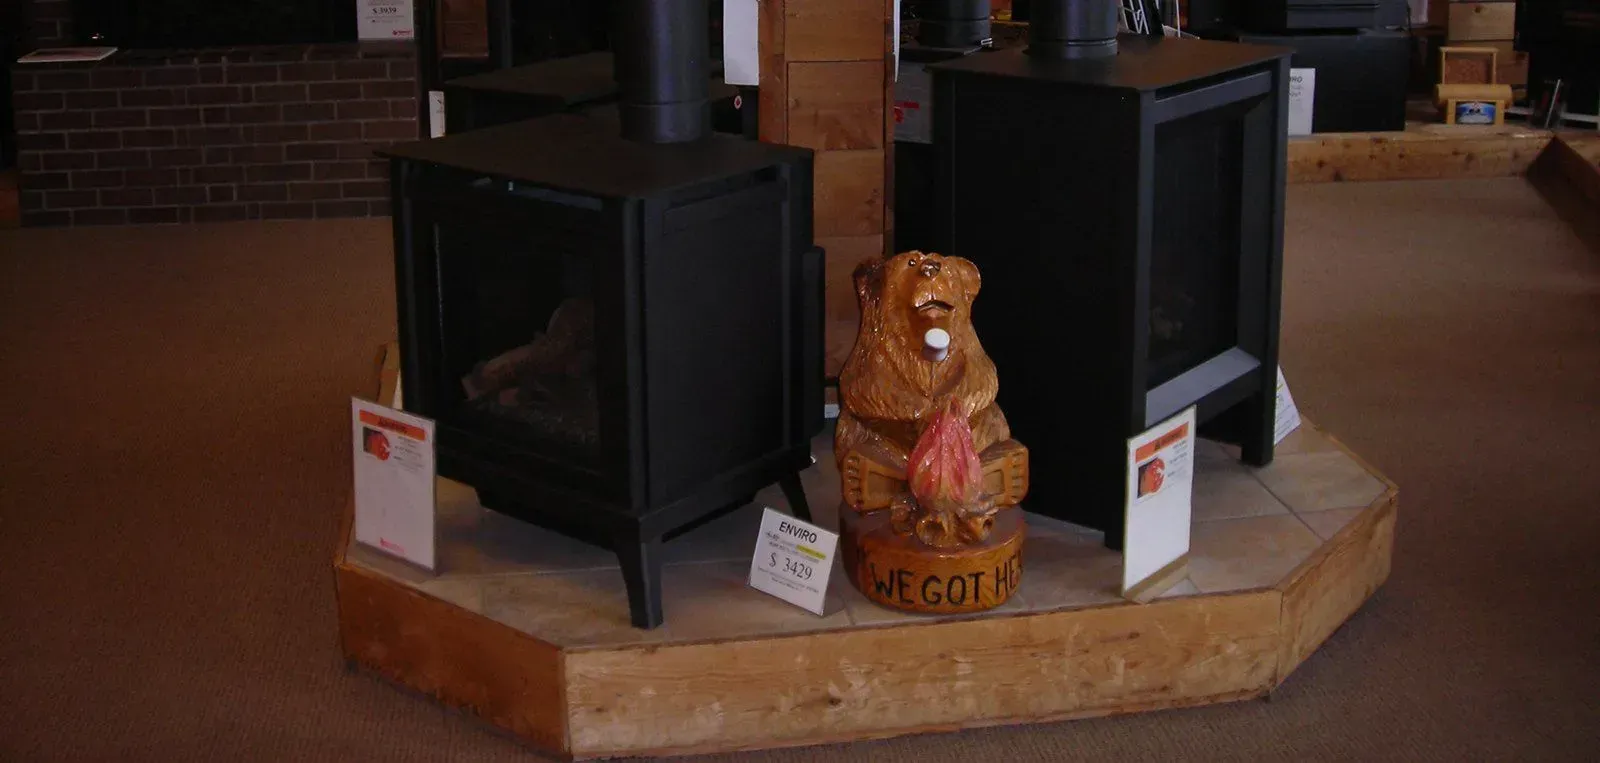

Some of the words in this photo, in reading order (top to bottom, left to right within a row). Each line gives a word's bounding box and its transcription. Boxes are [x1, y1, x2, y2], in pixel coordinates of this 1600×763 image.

[778, 521, 818, 544] ENVIRO
[768, 552, 777, 568] $
[782, 557, 813, 580] 3429
[869, 562, 915, 604] WE
[921, 571, 985, 606] GOT
